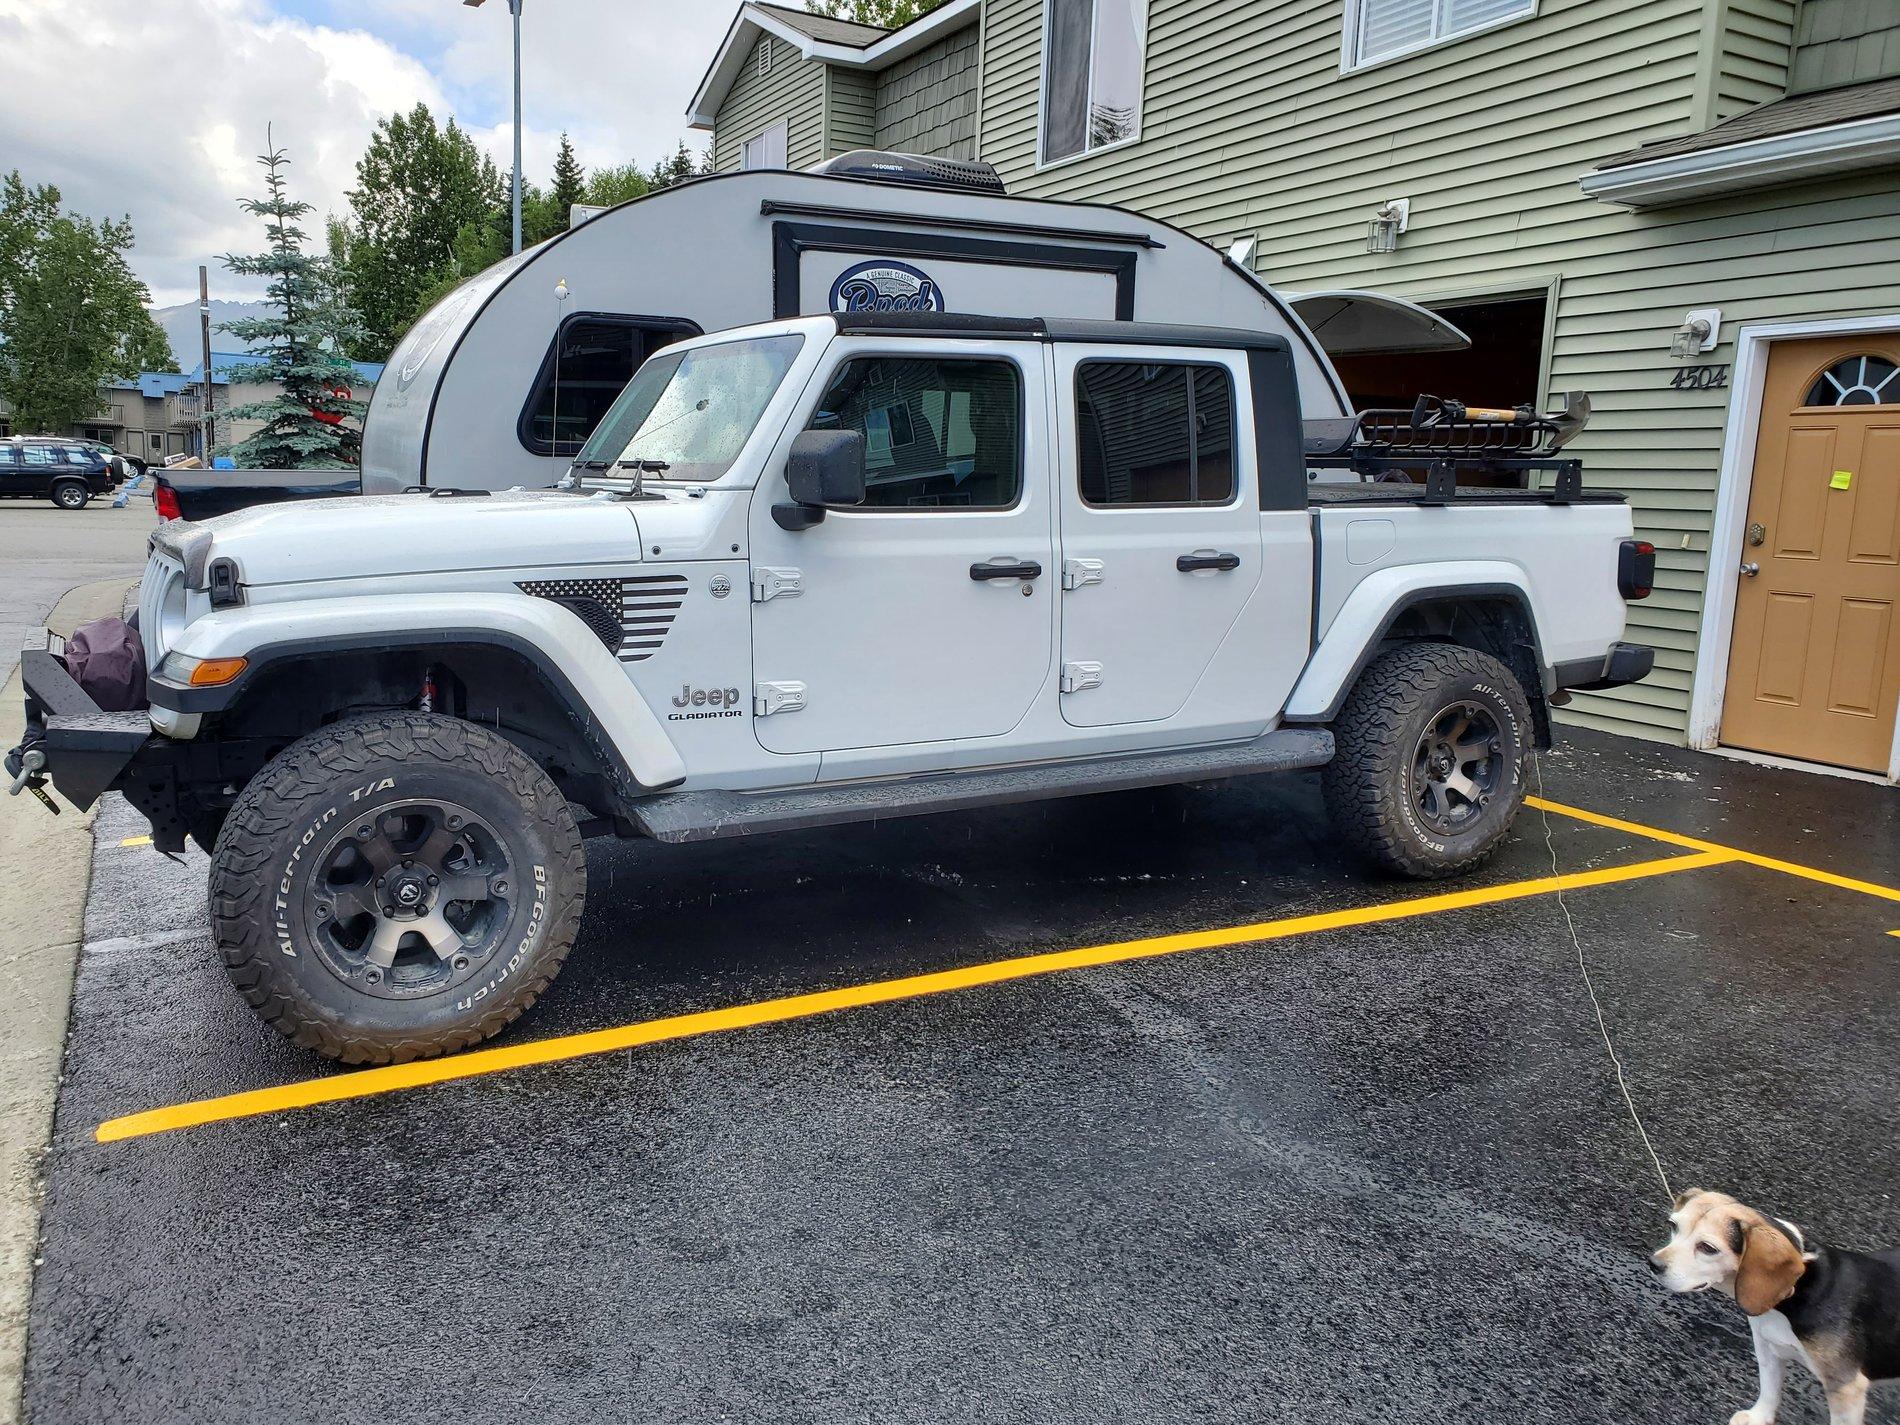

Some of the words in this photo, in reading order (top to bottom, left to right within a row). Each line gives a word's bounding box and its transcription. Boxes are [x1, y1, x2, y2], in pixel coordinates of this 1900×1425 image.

[879, 163, 904, 171] DOMETIC
[871, 270, 894, 278] GENUINE
[894, 271, 915, 284] CLASSIC
[1669, 365, 1728, 391] 4504
[671, 683, 740, 709] Jeep
[668, 710, 742, 721] GLADIATOR
[1472, 683, 1522, 749] All-Terrain
[1511, 757, 1522, 785] T/A
[1400, 765, 1445, 852] BFGoodrich
[274, 806, 338, 958] All-Terrain
[349, 777, 396, 802] T/A
[457, 865, 547, 1011] BFGoodrich
